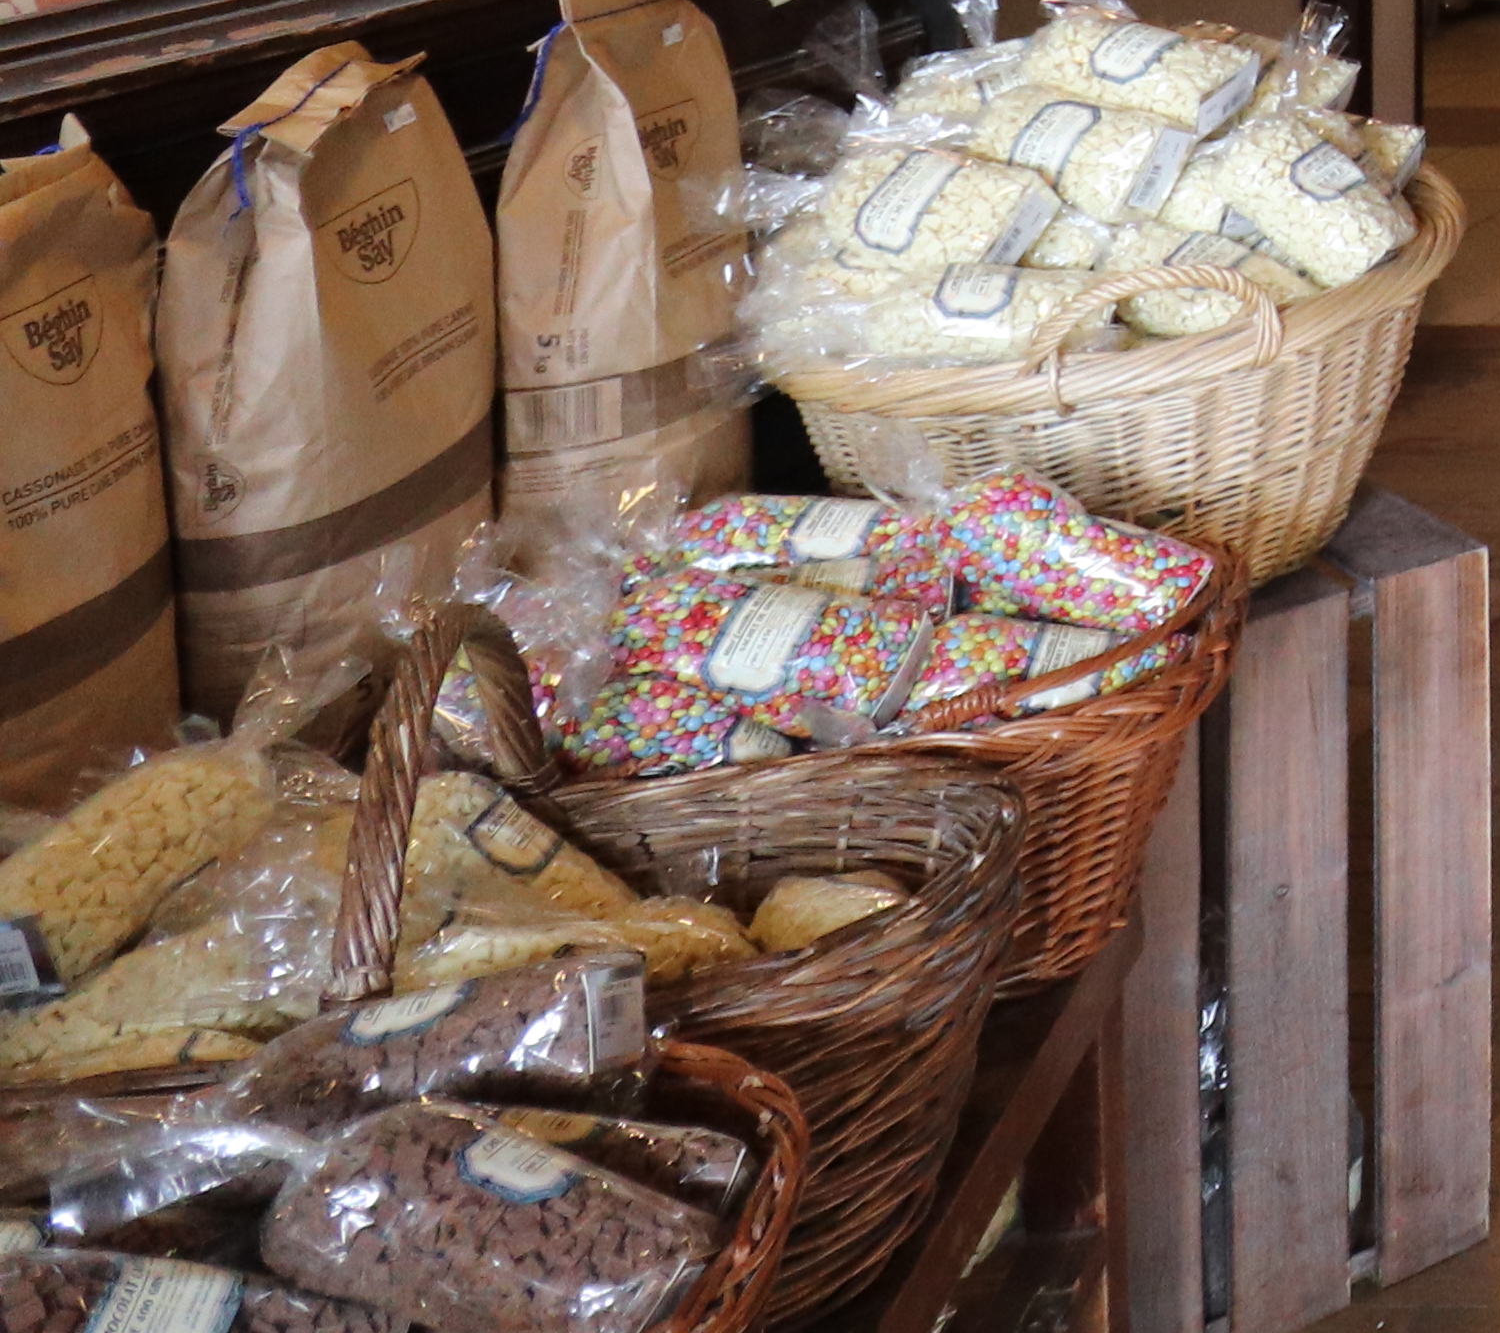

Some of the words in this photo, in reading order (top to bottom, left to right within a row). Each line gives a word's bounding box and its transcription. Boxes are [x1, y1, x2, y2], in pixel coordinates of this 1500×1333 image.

[336, 203, 405, 255] Béghin
[356, 231, 396, 272] Say
[23, 298, 93, 350] Béghin
[47, 324, 84, 372] Say
[2, 459, 88, 506] CASSONADE
[50, 485, 91, 517] PURE
